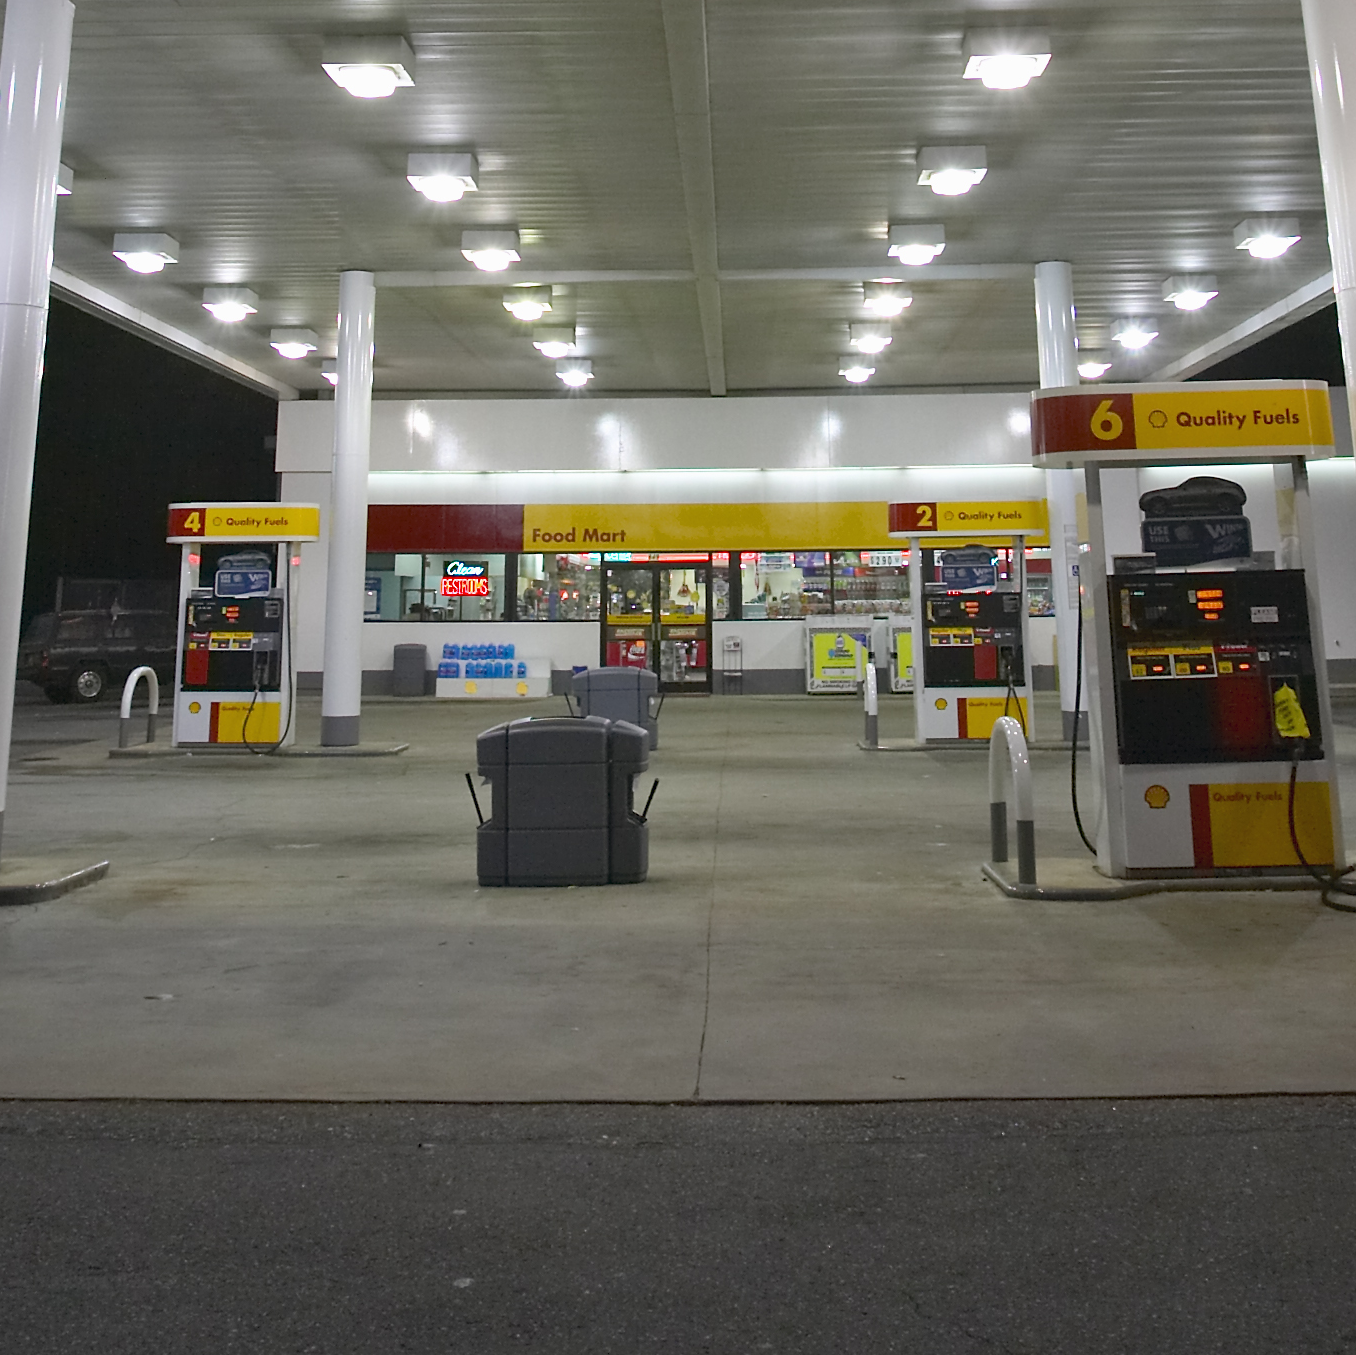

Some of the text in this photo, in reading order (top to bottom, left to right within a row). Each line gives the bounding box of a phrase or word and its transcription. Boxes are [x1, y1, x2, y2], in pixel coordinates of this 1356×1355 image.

[1090, 399, 1300, 441] 6 Quality Fuels
[184, 512, 289, 533] 4 Quality Fuels
[916, 505, 1023, 527] 2 Quality Fuels
[532, 527, 627, 543] Food Mart
[1148, 526, 1169, 535] USE
[447, 561, 484, 576] Clean
[441, 577, 488, 596] RESTROOMS
[1212, 790, 1283, 805] Quality Fuels
